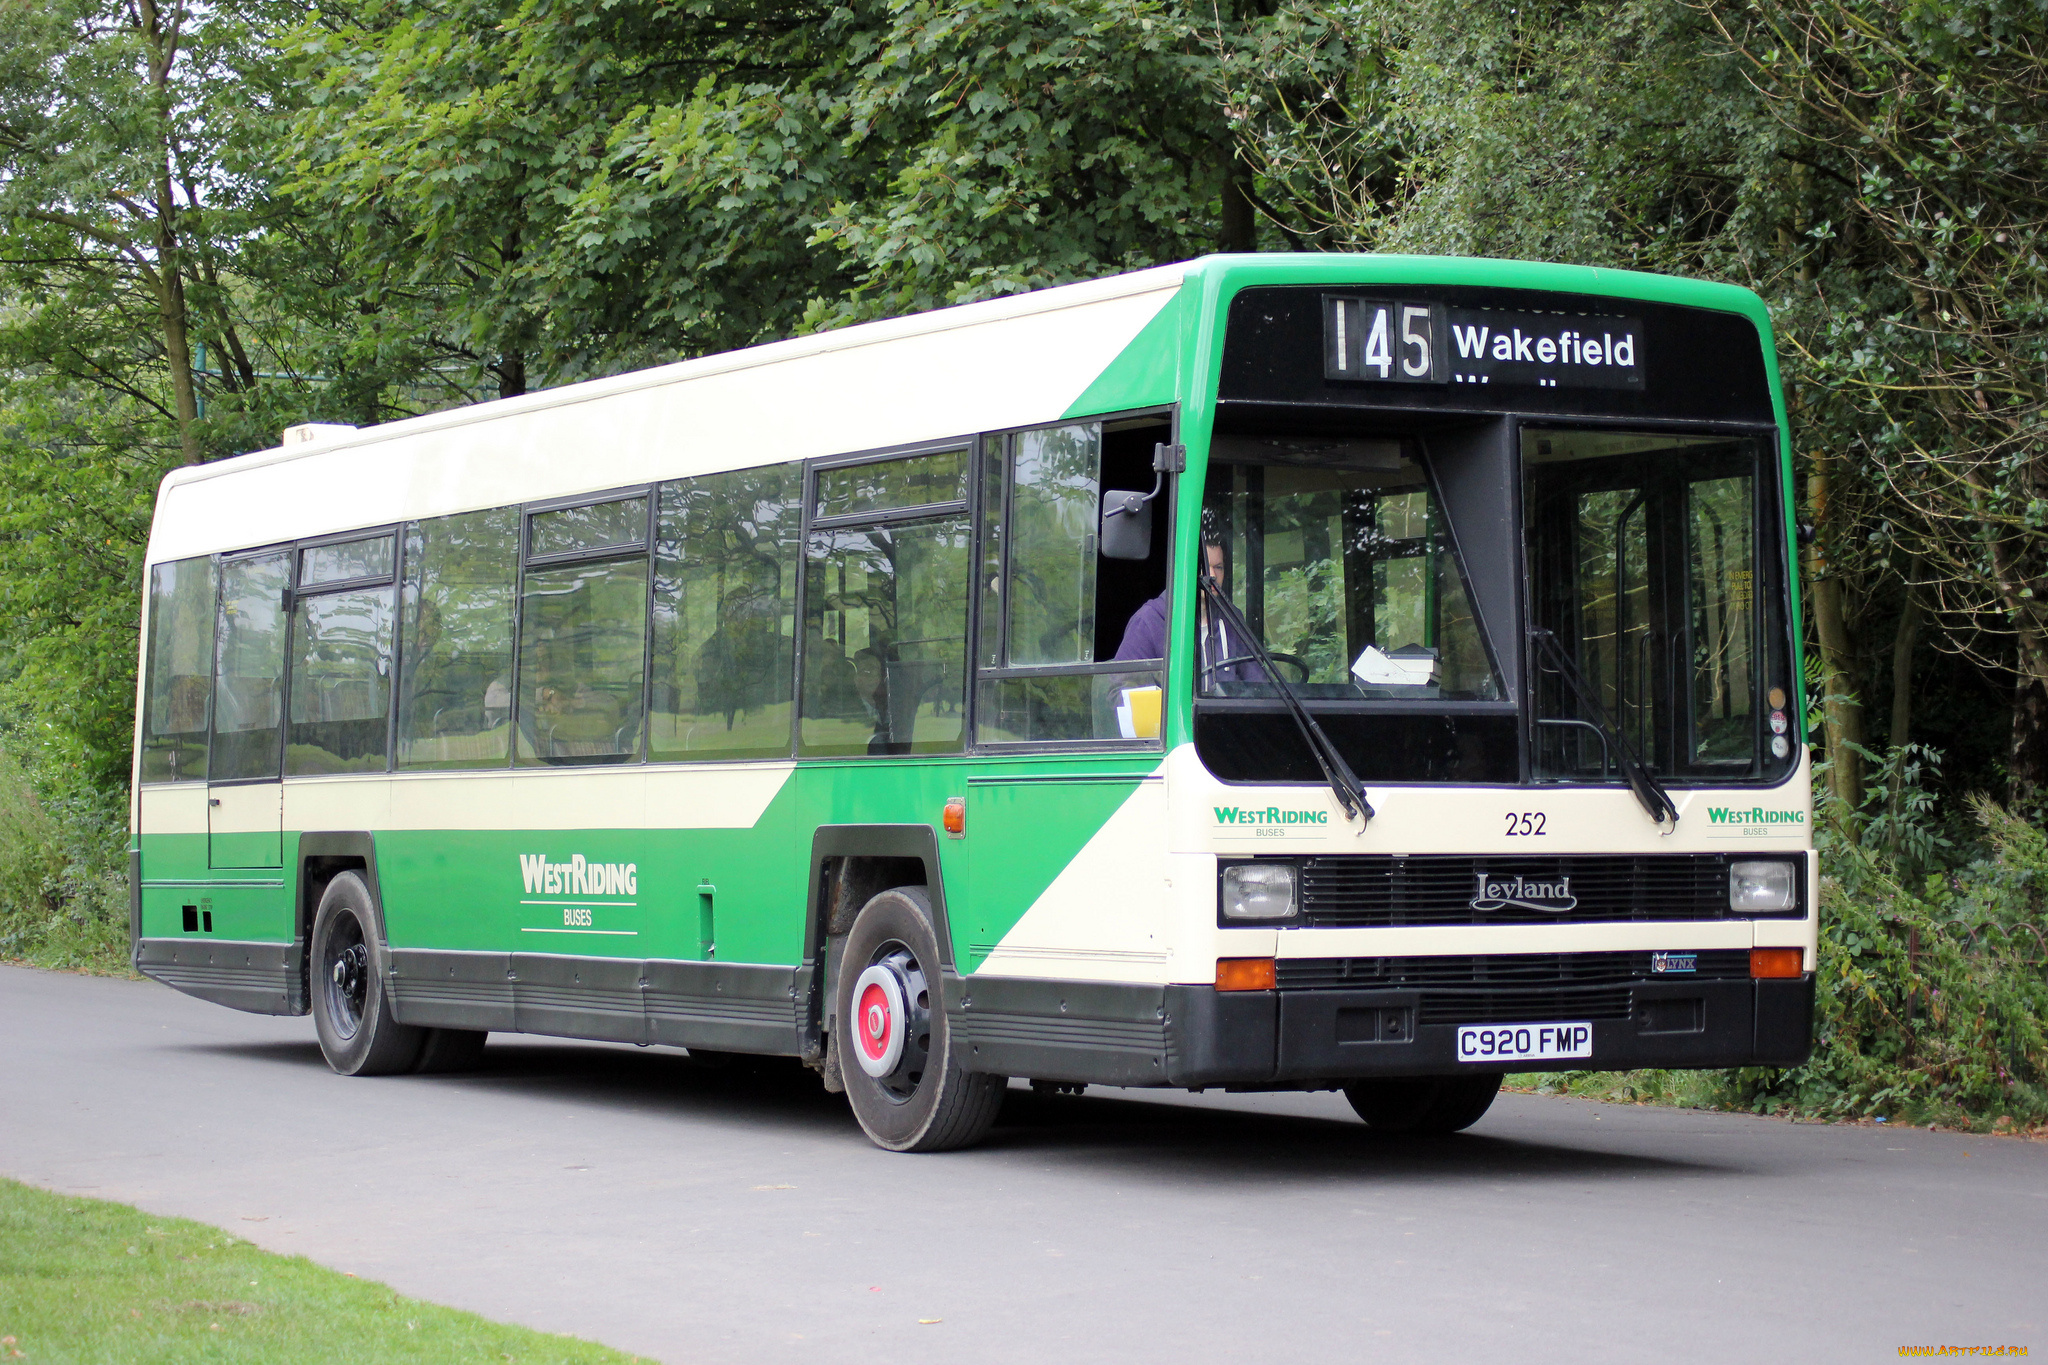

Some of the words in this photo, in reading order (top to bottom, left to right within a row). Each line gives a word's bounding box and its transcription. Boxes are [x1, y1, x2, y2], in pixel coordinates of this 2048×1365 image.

[1336, 300, 1430, 379] 145
[1453, 325, 1636, 367] Wakefield
[1255, 828, 1285, 837] BUSES
[1505, 812, 1547, 836] 252
[1743, 827, 1768, 836] BUSES
[1475, 873, 1571, 901] Leyland
[563, 908, 592, 927] BUSES
[1666, 958, 1695, 970] LYNX
[1461, 1028, 1532, 1056] C920
[1539, 1026, 1589, 1053] FMP
